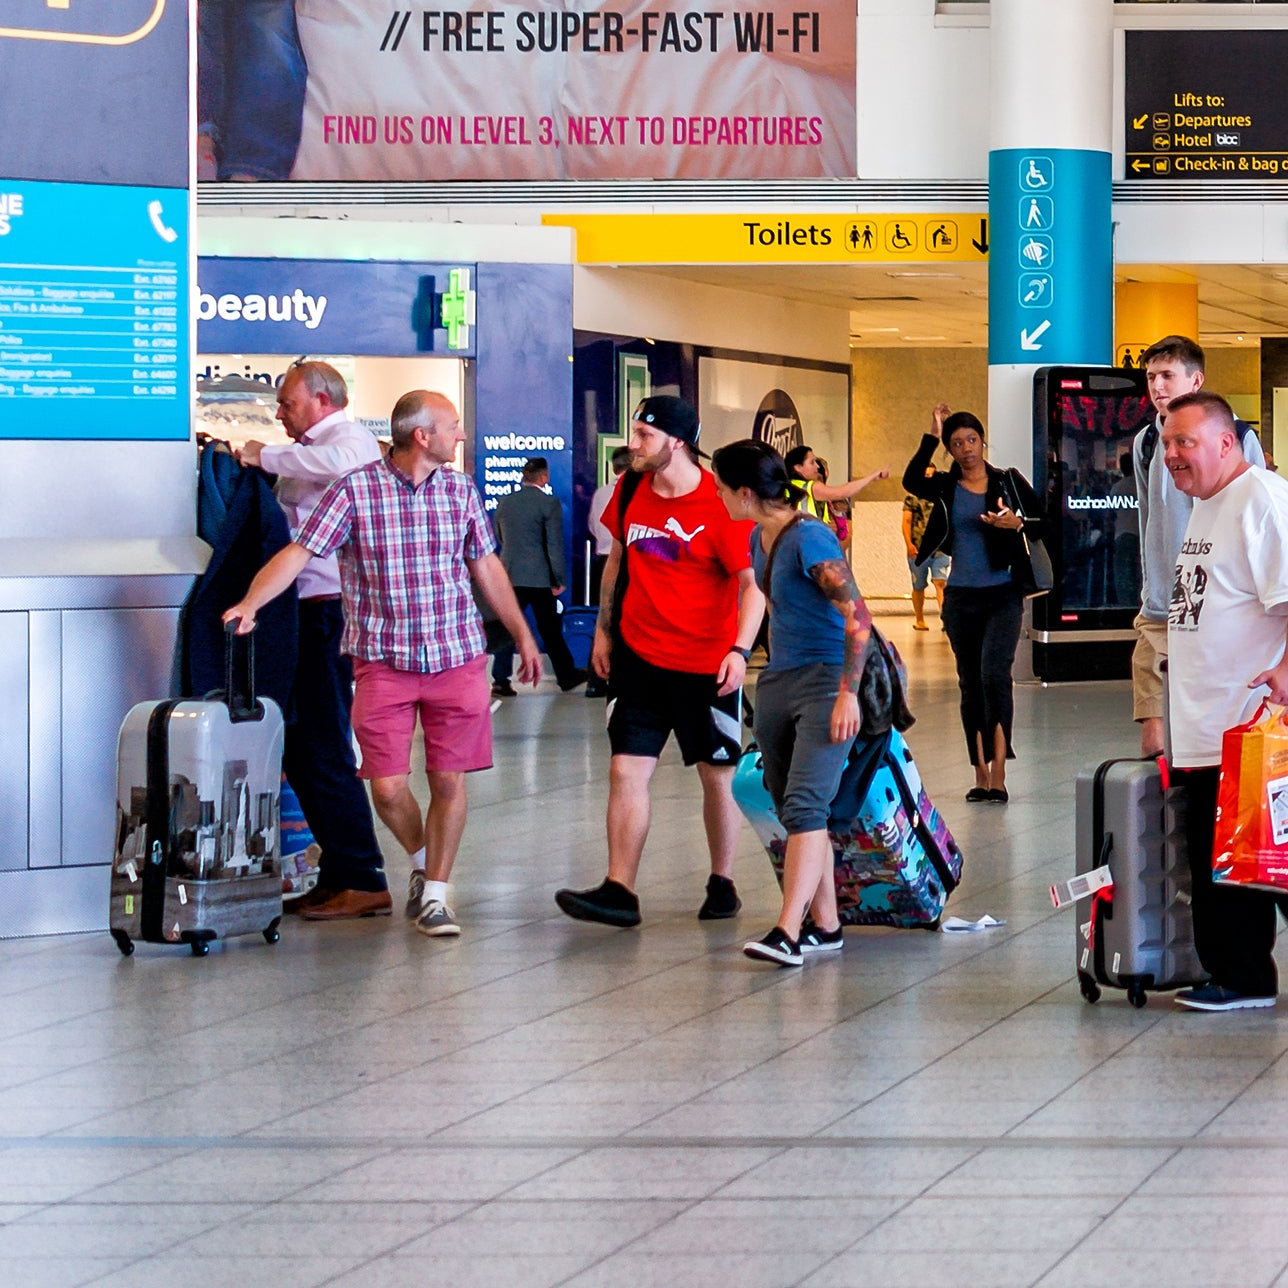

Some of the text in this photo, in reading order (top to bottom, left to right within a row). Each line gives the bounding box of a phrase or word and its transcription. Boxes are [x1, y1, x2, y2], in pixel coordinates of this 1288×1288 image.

[423, 11, 505, 52] FREE
[516, 11, 722, 53] SUPER-FAST
[734, 11, 820, 53] WI-FI
[1174, 93, 1225, 107] Lifts to:
[1174, 114, 1252, 129] Departures
[323, 115, 823, 149] FIND US ON LEVEL 3, NEXT TO DEPARTURES
[1174, 133, 1239, 147] Hotel bloc
[1174, 157, 1235, 171] Check-in
[1238, 157, 1249, 171] &
[1252, 157, 1279, 174] bag
[743, 222, 832, 246] Toilets
[196, 285, 328, 329] beauty
[484, 432, 565, 450] welcome
